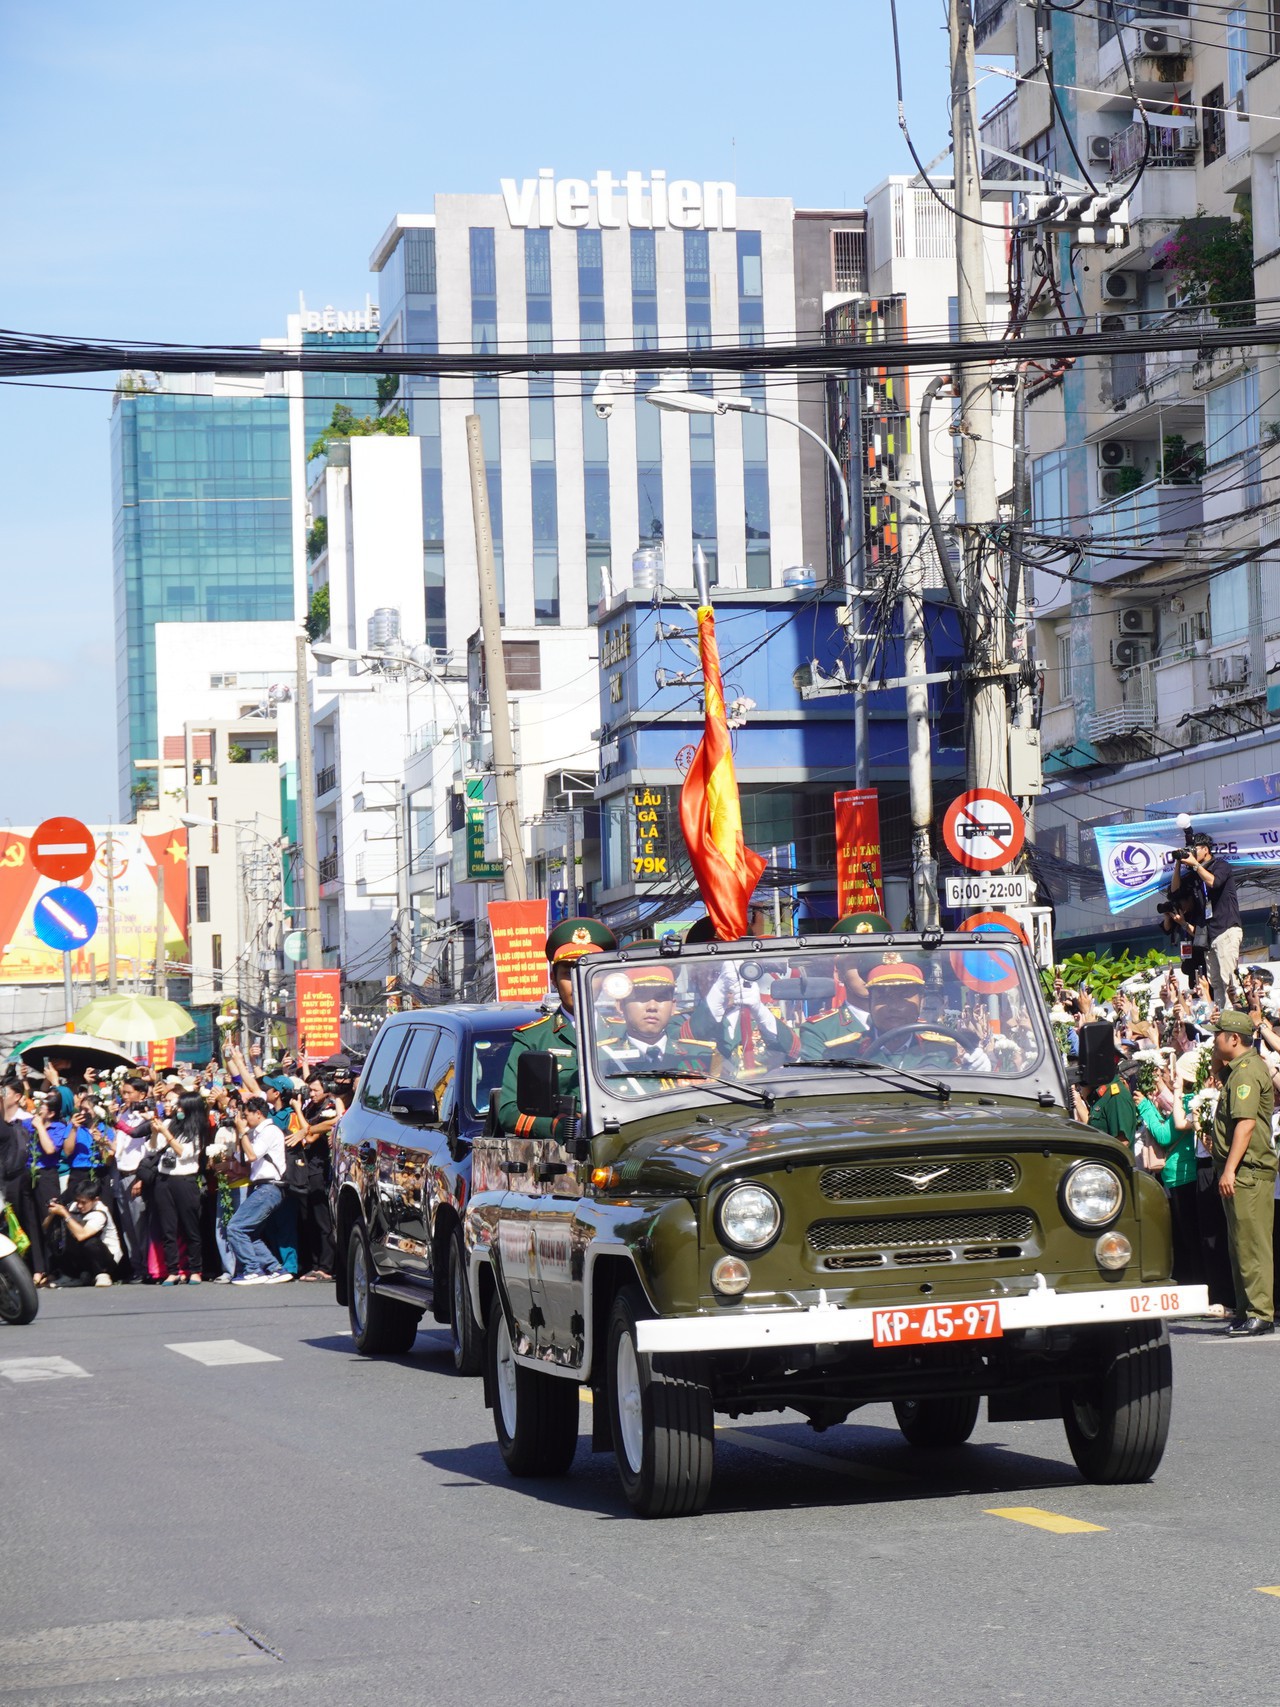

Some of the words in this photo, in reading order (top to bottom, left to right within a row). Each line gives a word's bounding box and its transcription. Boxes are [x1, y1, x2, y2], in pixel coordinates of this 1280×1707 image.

[500, 168, 736, 230] viettien
[634, 788, 662, 806] LẨU
[1222, 793, 1245, 809] TOSHIBA
[638, 808, 658, 822] GÀ
[640, 824, 658, 838] LÁ
[1260, 830, 1278, 844] TỪ
[645, 840, 654, 854] É
[633, 858, 666, 873] 79K
[952, 884, 980, 900] 6:00
[990, 882, 1022, 898] 22:00
[1130, 1294, 1180, 1313] 02-08
[876, 1304, 996, 1343] KP-45-97
